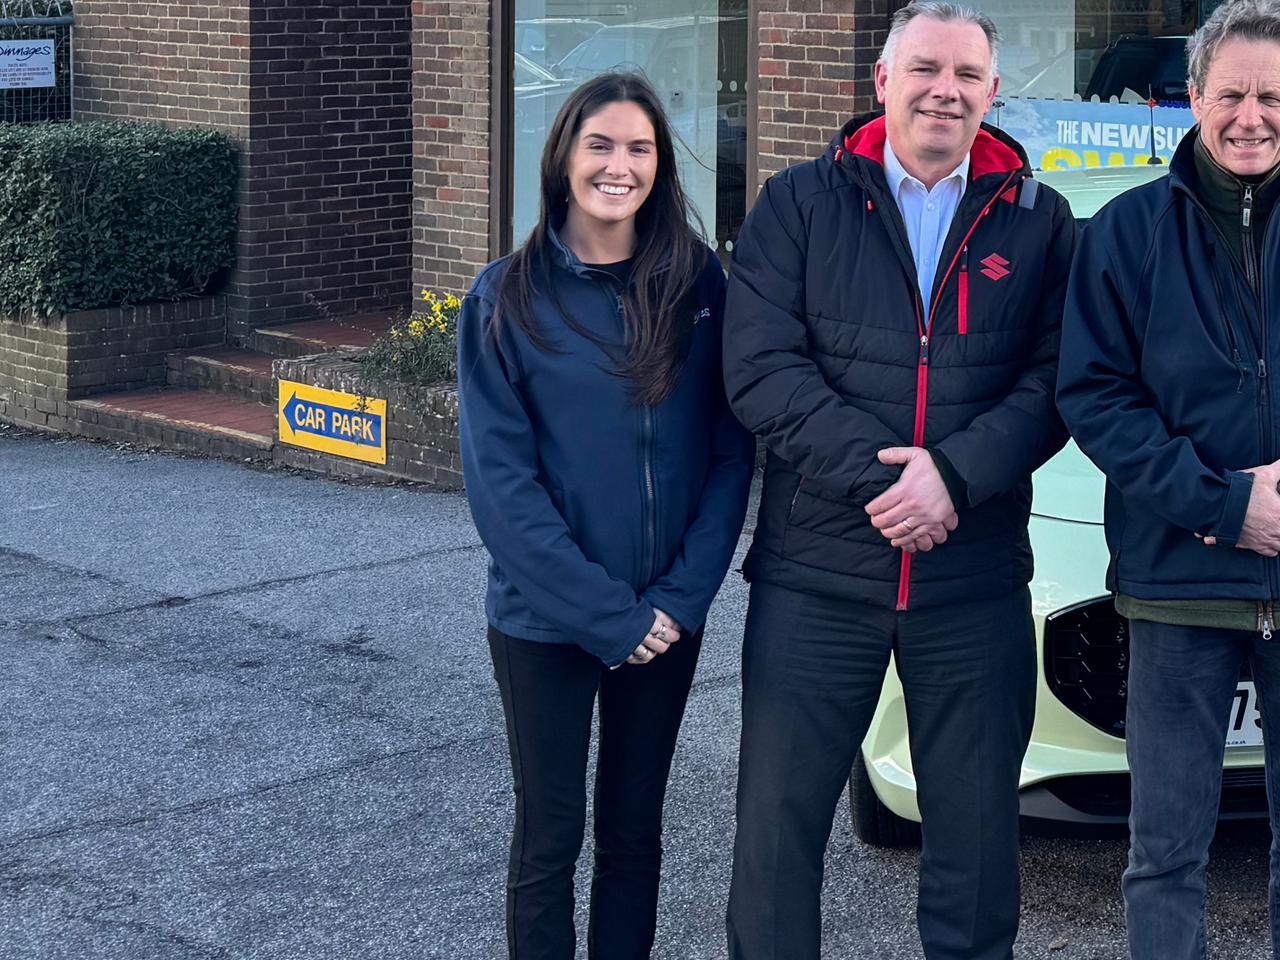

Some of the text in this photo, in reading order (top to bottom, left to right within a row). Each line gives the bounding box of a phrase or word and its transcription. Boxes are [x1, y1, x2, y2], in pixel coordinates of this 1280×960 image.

[1056, 120, 1080, 145] THE
[1081, 121, 1150, 149] NEW
[294, 403, 375, 442] CAR PARK
